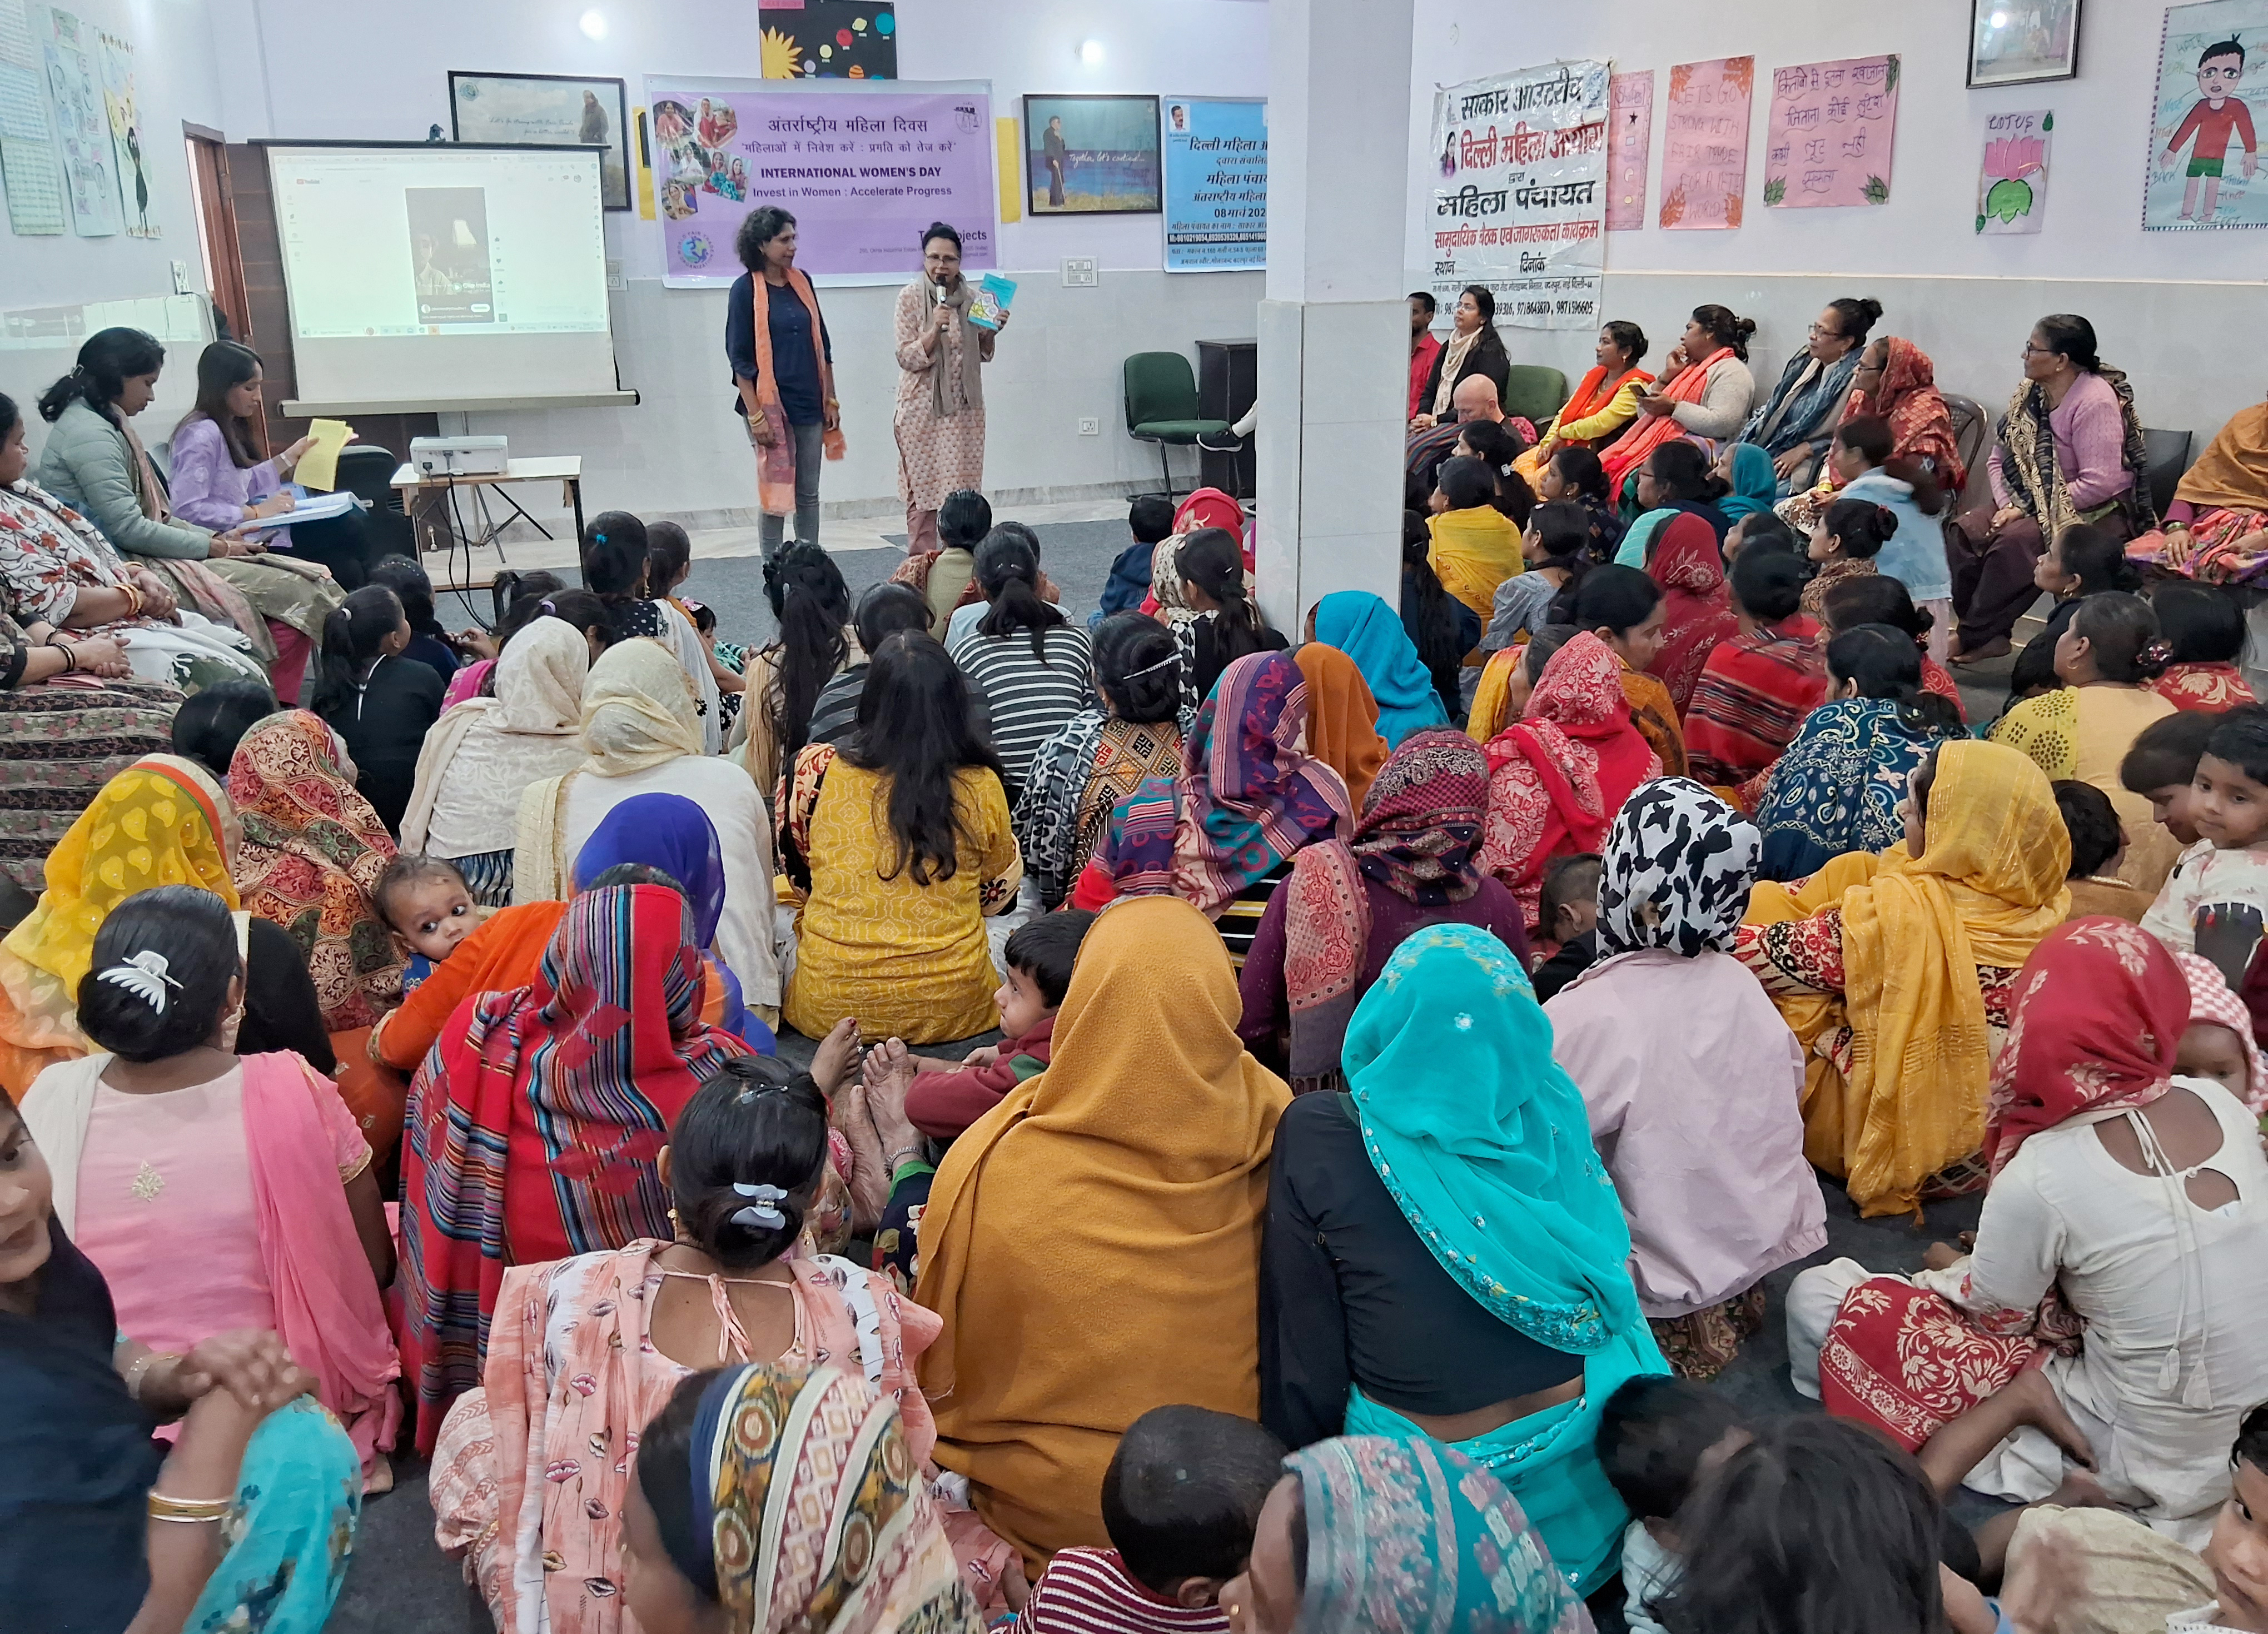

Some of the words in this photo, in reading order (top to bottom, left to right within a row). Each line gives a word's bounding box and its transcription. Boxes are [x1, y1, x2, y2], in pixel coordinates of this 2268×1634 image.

[1461, 87, 1510, 120] साकार
[768, 115, 838, 134] अंतर्राष्ट्रीय
[845, 116, 886, 132] महिला
[893, 116, 928, 132] दिवस
[1989, 114, 2034, 133] LOTUS
[807, 141, 834, 153] निवेश
[839, 141, 855, 153] करें
[869, 140, 893, 153] प्रगति
[898, 140, 911, 153] को
[917, 140, 933, 153] तेज
[1190, 136, 1220, 151] दिल्ली
[1223, 136, 1257, 153] महिला
[1460, 124, 1498, 170] दिल्ली
[1501, 121, 1549, 165] महिला
[760, 167, 857, 178] INTERNATIONAL
[859, 167, 916, 177] WOMEN'S
[919, 167, 942, 177] DAY
[1206, 170, 1241, 187] महिला
[753, 187, 786, 197] Invest
[789, 187, 798, 197] in
[801, 187, 841, 197] Women
[850, 186, 904, 196] Accelerate
[907, 186, 952, 198] Progress
[1239, 189, 1267, 203] महिला
[1437, 185, 1509, 217] महिला
[1516, 178, 1596, 210] पंचायत
[1248, 208, 1266, 217] 202
[955, 230, 987, 243] ojects
[1435, 261, 1455, 276] स्थान
[1520, 251, 1546, 273] दिनांक
